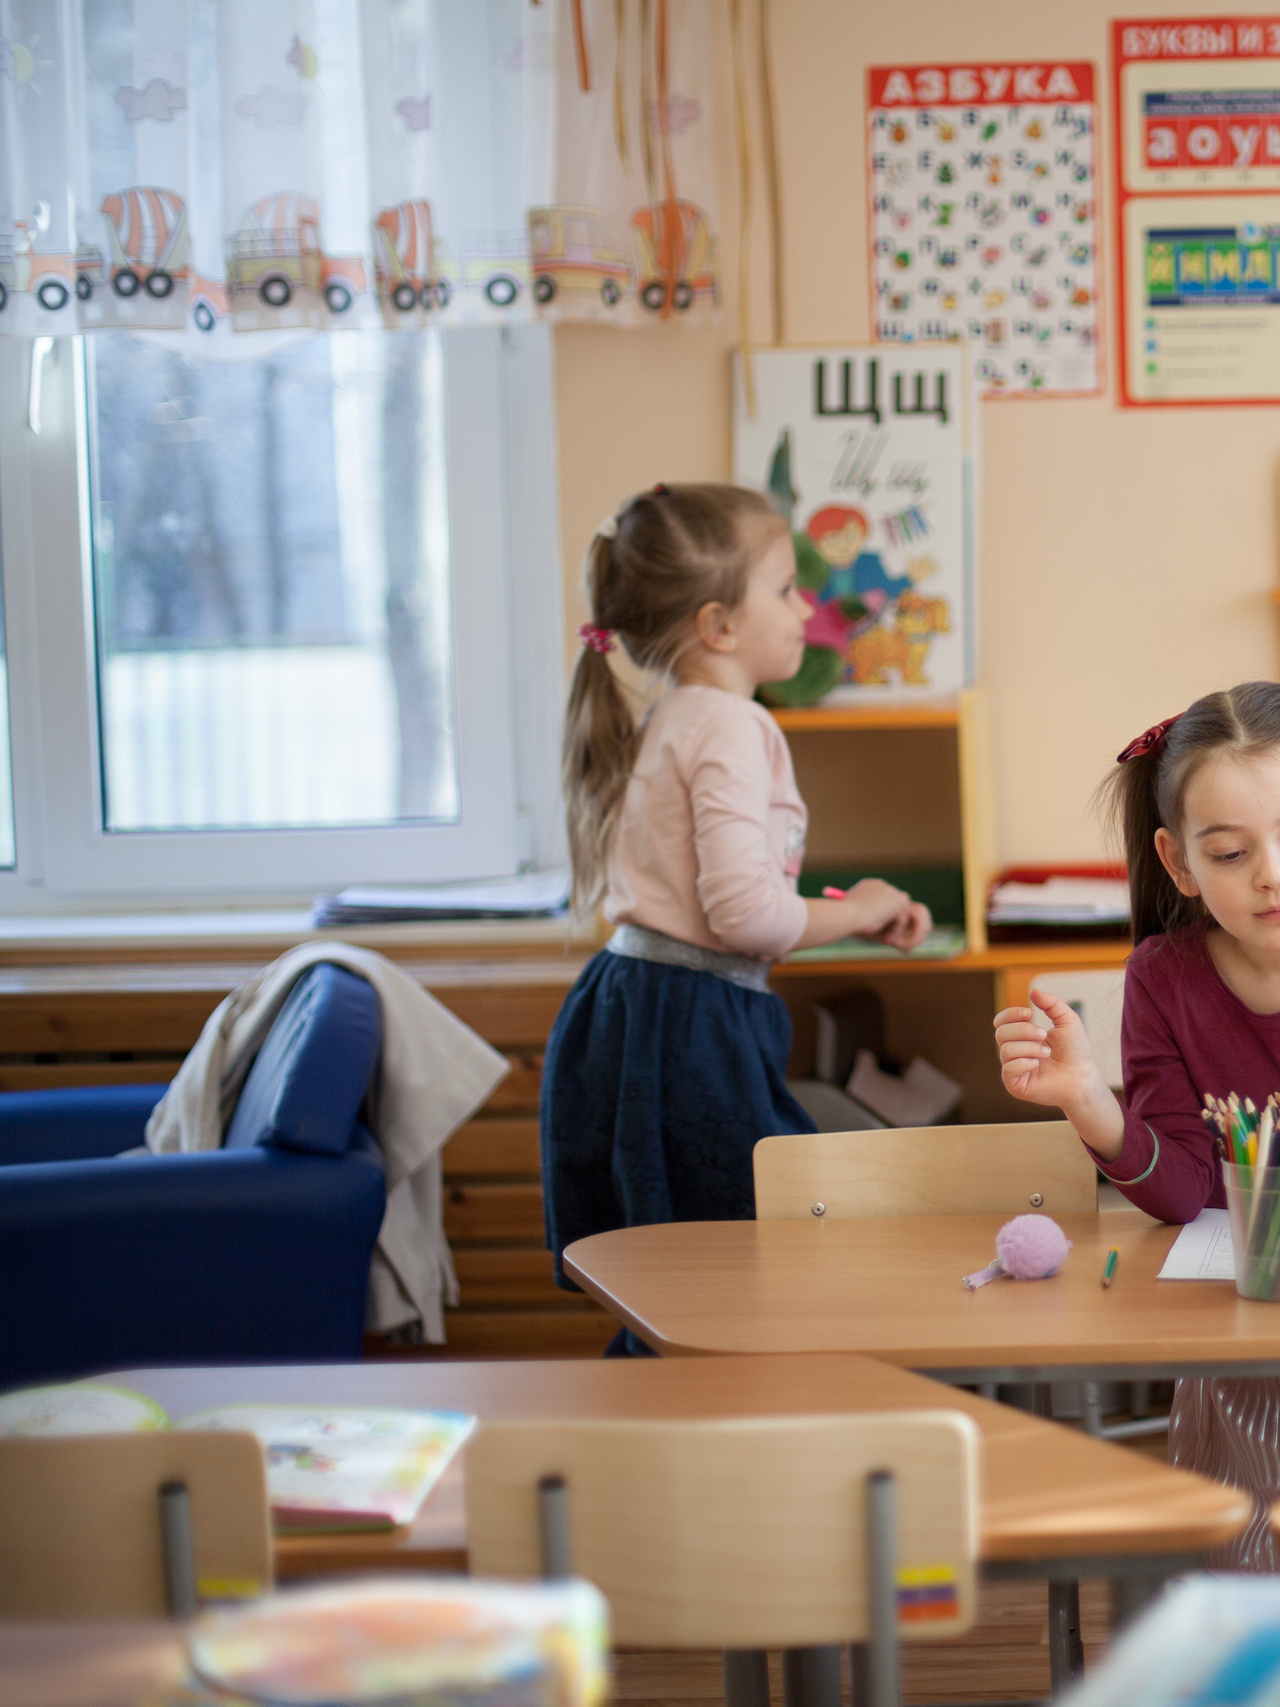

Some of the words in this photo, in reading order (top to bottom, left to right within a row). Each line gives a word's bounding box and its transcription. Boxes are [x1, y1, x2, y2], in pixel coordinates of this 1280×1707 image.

[1122, 23, 1234, 57] БУКВЫ
[1237, 23, 1263, 54] И
[880, 65, 1079, 103] АЗБУКА
